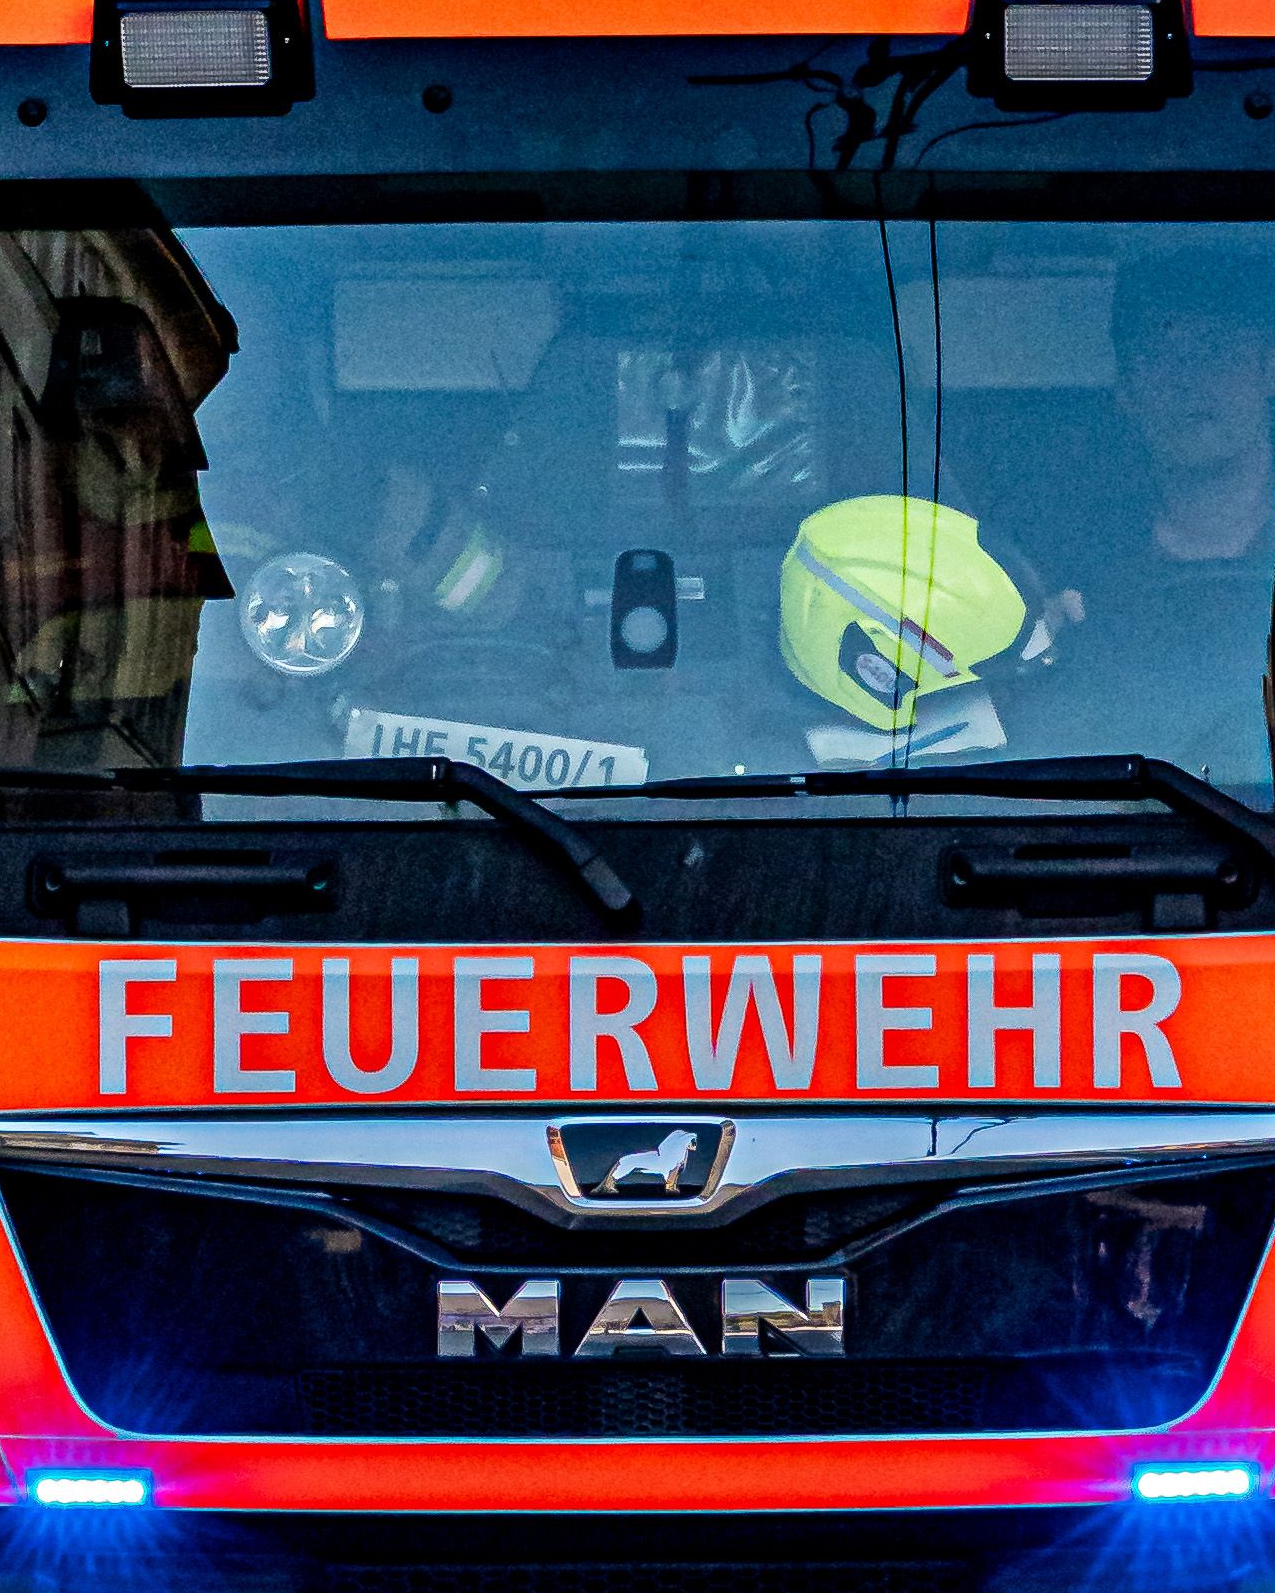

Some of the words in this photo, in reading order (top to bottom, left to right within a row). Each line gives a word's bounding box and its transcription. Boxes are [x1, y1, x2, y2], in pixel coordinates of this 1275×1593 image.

[467, 735, 615, 786] 5400/1
[99, 953, 1183, 1094] FEUERWEHR
[437, 1278, 845, 1356] MAN
